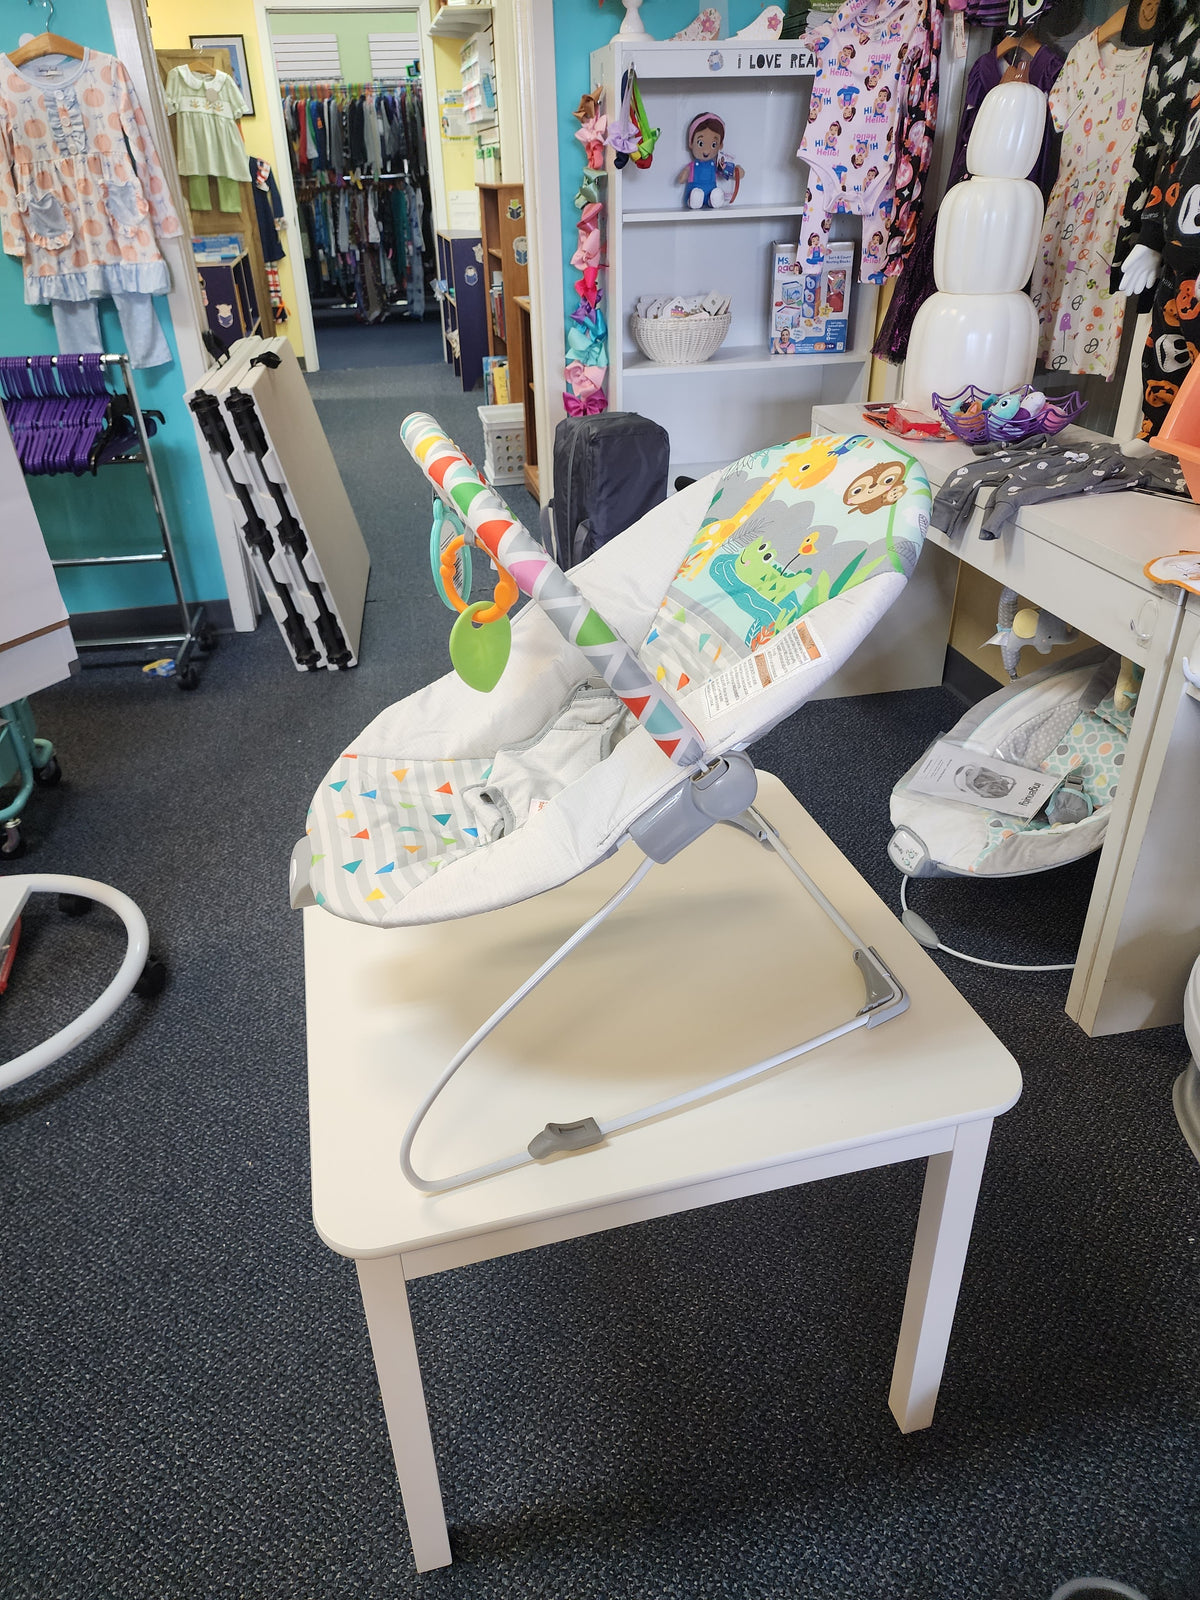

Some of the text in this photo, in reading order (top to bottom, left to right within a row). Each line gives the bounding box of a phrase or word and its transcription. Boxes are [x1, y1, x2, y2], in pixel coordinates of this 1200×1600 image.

[750, 54, 782, 69] LOVE
[828, 59, 837, 67] Hi
[830, 68, 852, 77] Hello!
[823, 97, 832, 105] Hi
[863, 107, 872, 115] Hi
[865, 115, 889, 124] Hello!
[853, 132, 877, 141] Hello!
[815, 139, 824, 147] Hi
[870, 142, 879, 150] Hi
[816, 149, 840, 157] Hello!
